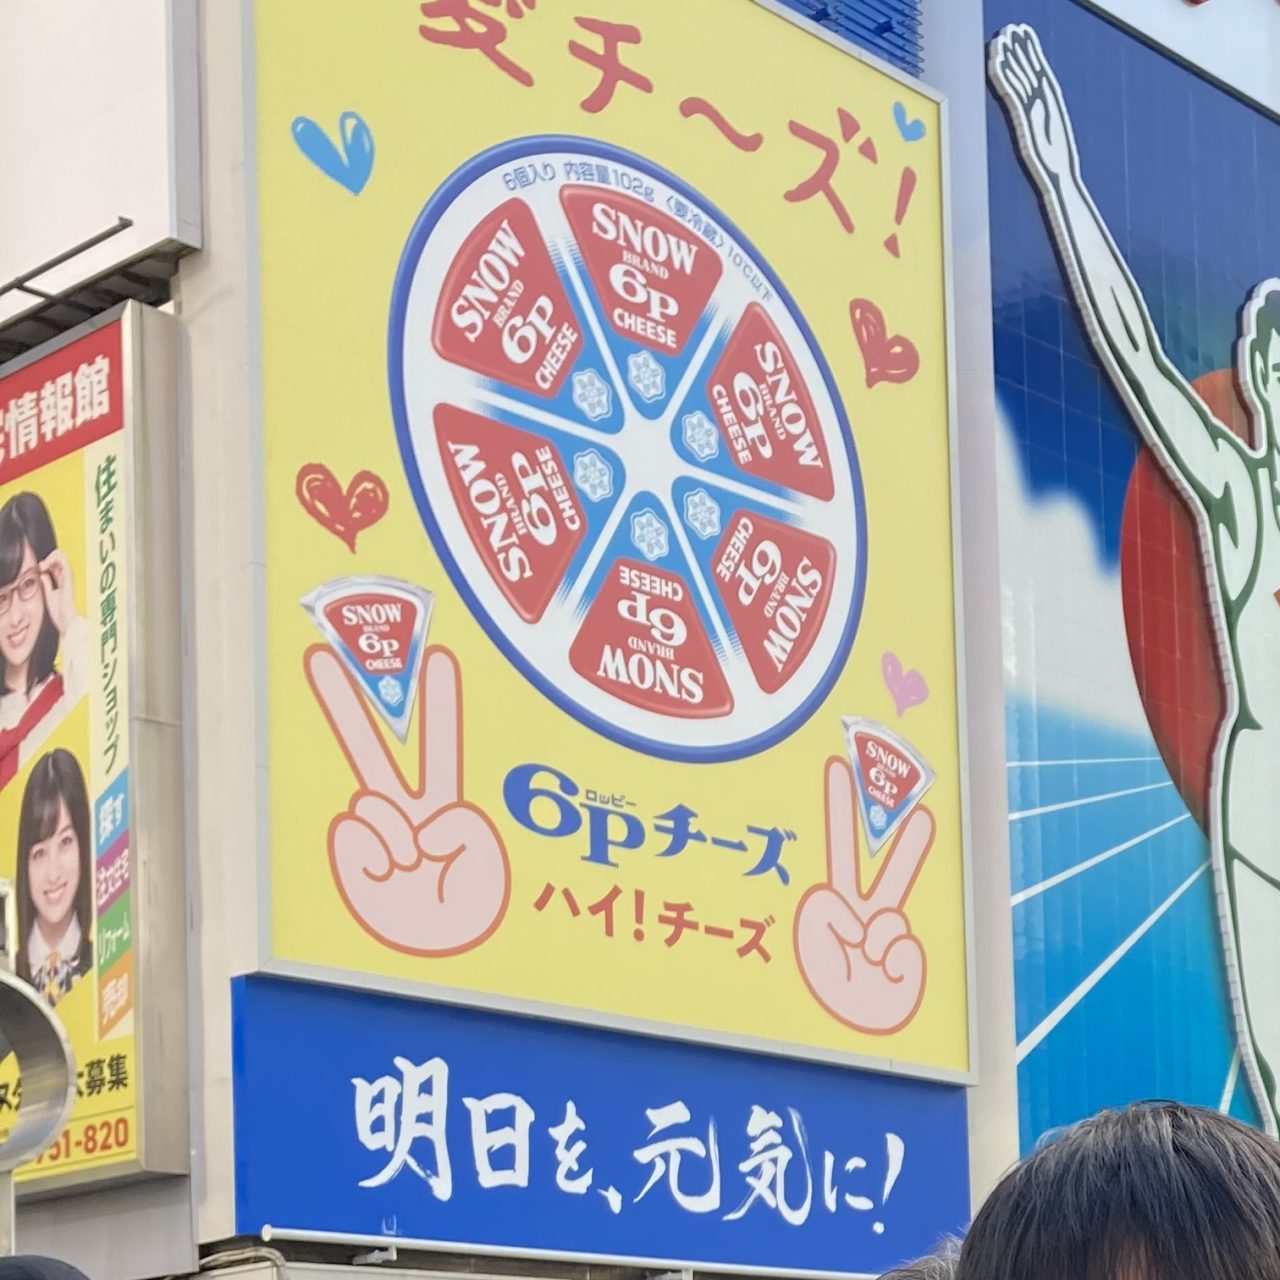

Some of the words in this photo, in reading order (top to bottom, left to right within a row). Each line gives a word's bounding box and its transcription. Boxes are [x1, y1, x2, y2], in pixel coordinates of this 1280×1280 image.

[591, 202, 698, 275] SNOW
[451, 219, 526, 343] SNOW
[609, 263, 679, 323] 6P
[502, 295, 557, 364] 6P
[535, 322, 579, 390] CHEESE
[612, 307, 677, 348] CHEESE
[712, 384, 752, 464] CHEESE
[733, 371, 773, 459] 6P
[754, 341, 823, 469] SNOW
[447, 441, 533, 582] SNOW
[511, 451, 557, 546] 6P
[535, 445, 581, 531] CHEESE
[619, 565, 683, 601] CHEESE
[716, 516, 754, 582] CHEESE
[735, 539, 782, 606] 6P
[94, 454, 119, 775] 住まいの専門ショップ
[342, 603, 402, 625] SNOW
[617, 591, 687, 646] 6P
[763, 556, 823, 672] SNOW
[597, 644, 704, 704] SNOW
[866, 740, 911, 778] SNOW
[584, 789, 636, 808] ロッピー
[350, 1056, 906, 1235] 明日を、元気に!
